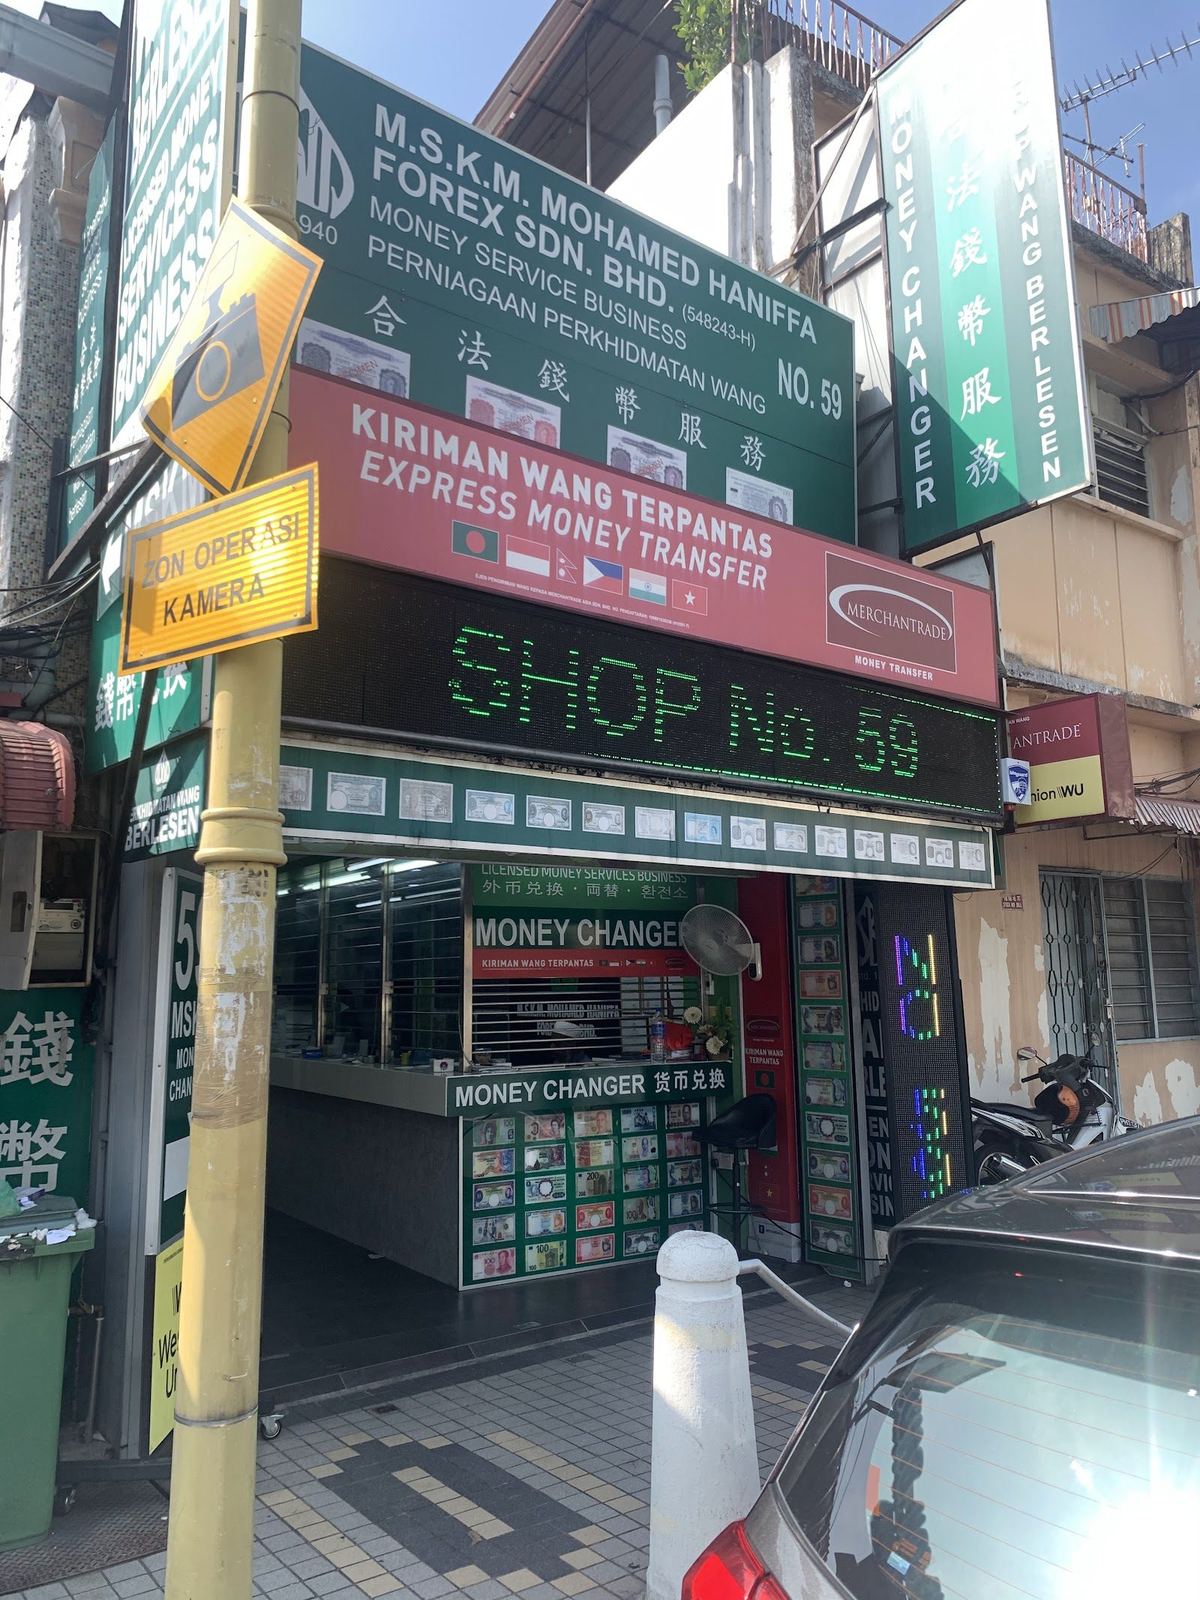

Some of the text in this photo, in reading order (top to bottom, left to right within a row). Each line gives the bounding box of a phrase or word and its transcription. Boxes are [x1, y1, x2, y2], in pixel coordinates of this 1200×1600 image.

[373, 103, 818, 344] M.S.K.M. MOHAMED HANIFFA
[1012, 165, 1044, 268] WANG
[369, 194, 688, 351] MONEY SERVICE BUSINESS
[372, 147, 757, 353] FOREX SDN. BHD. (548243-H)
[367, 233, 767, 415] PERNIAGAAN PERKHIDMATAN WANG
[777, 357, 843, 421] NO. 59
[900, 264, 937, 510] CHANGER
[1024, 278, 1063, 484] BERLESEN
[351, 402, 772, 559] KIRIMAN WANG TERPANTAS
[142, 510, 301, 589] ZON OPERASI
[359, 452, 768, 591] EXPRESS MONEY TRANSFER
[163, 572, 266, 627] KAMERA
[846, 599, 953, 644] MERCHANTRADE
[854, 654, 935, 682] MONEY TRANSFER
[449, 626, 919, 778] SHOP No. 59
[176, 785, 201, 807] WANG
[1061, 783, 1084, 799] WU
[124, 805, 201, 852] BERLESEN
[481, 864, 688, 884] LICENSED MONEY SERVICES BUSINESS
[475, 918, 568, 947] MONEY
[481, 958, 594, 968] KIRIMAN WANG TERPANTAS
[455, 1067, 726, 1108] MONEY CHANGER 货币兑换
[749, 1056, 780, 1066] TERPANTAS
[536, 1243, 550, 1254] 100
